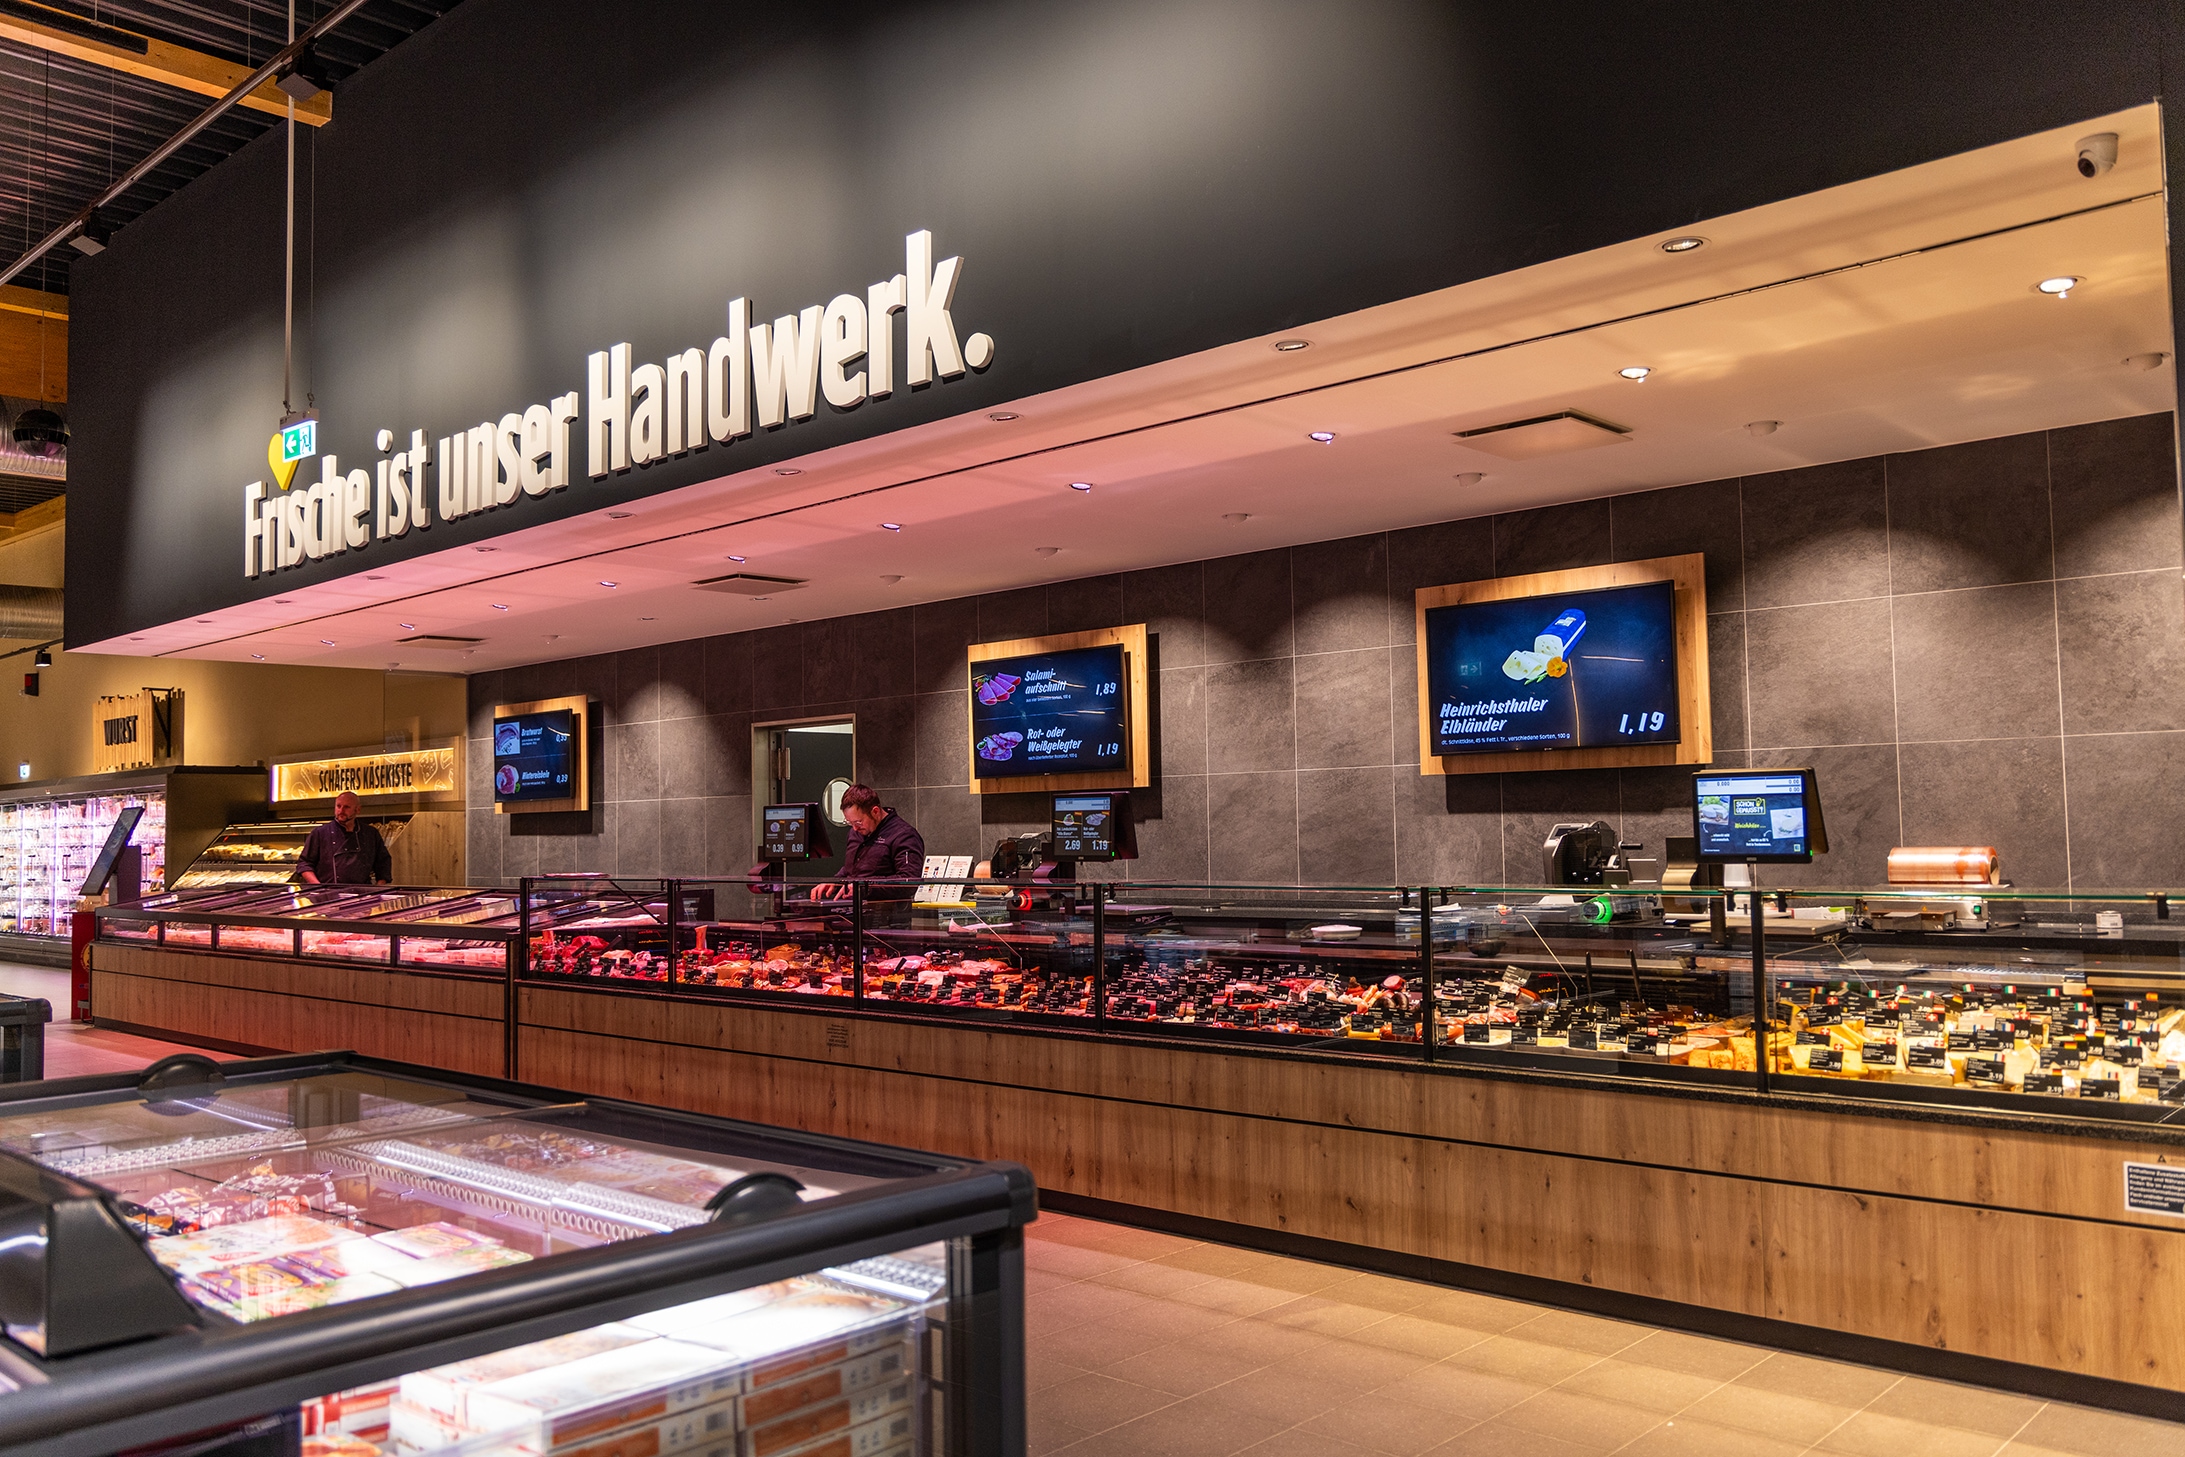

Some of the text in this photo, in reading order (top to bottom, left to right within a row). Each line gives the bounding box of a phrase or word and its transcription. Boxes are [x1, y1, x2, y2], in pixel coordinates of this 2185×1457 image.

[245, 229, 995, 578] Frische ist unser Handwerk.
[1025, 668, 1056, 682] Salami-
[1025, 680, 1067, 695] aufschnitt
[1095, 682, 1117, 697] 1,89
[1439, 697, 1548, 718] Heinrichsthaler
[104, 715, 138, 746] WURST
[1440, 717, 1508, 735] Elbländer
[1619, 711, 1665, 736] 1,19
[1026, 727, 1067, 740] Rot- oder
[1027, 738, 1082, 755] Weißgelegter
[1097, 742, 1119, 757] 1,19
[319, 761, 412, 793] SCHÄFERS KÄSEKISTE
[772, 843, 784, 853] 0.39
[1064, 840, 1081, 850] 2.69
[1092, 840, 1108, 850] 1.19
